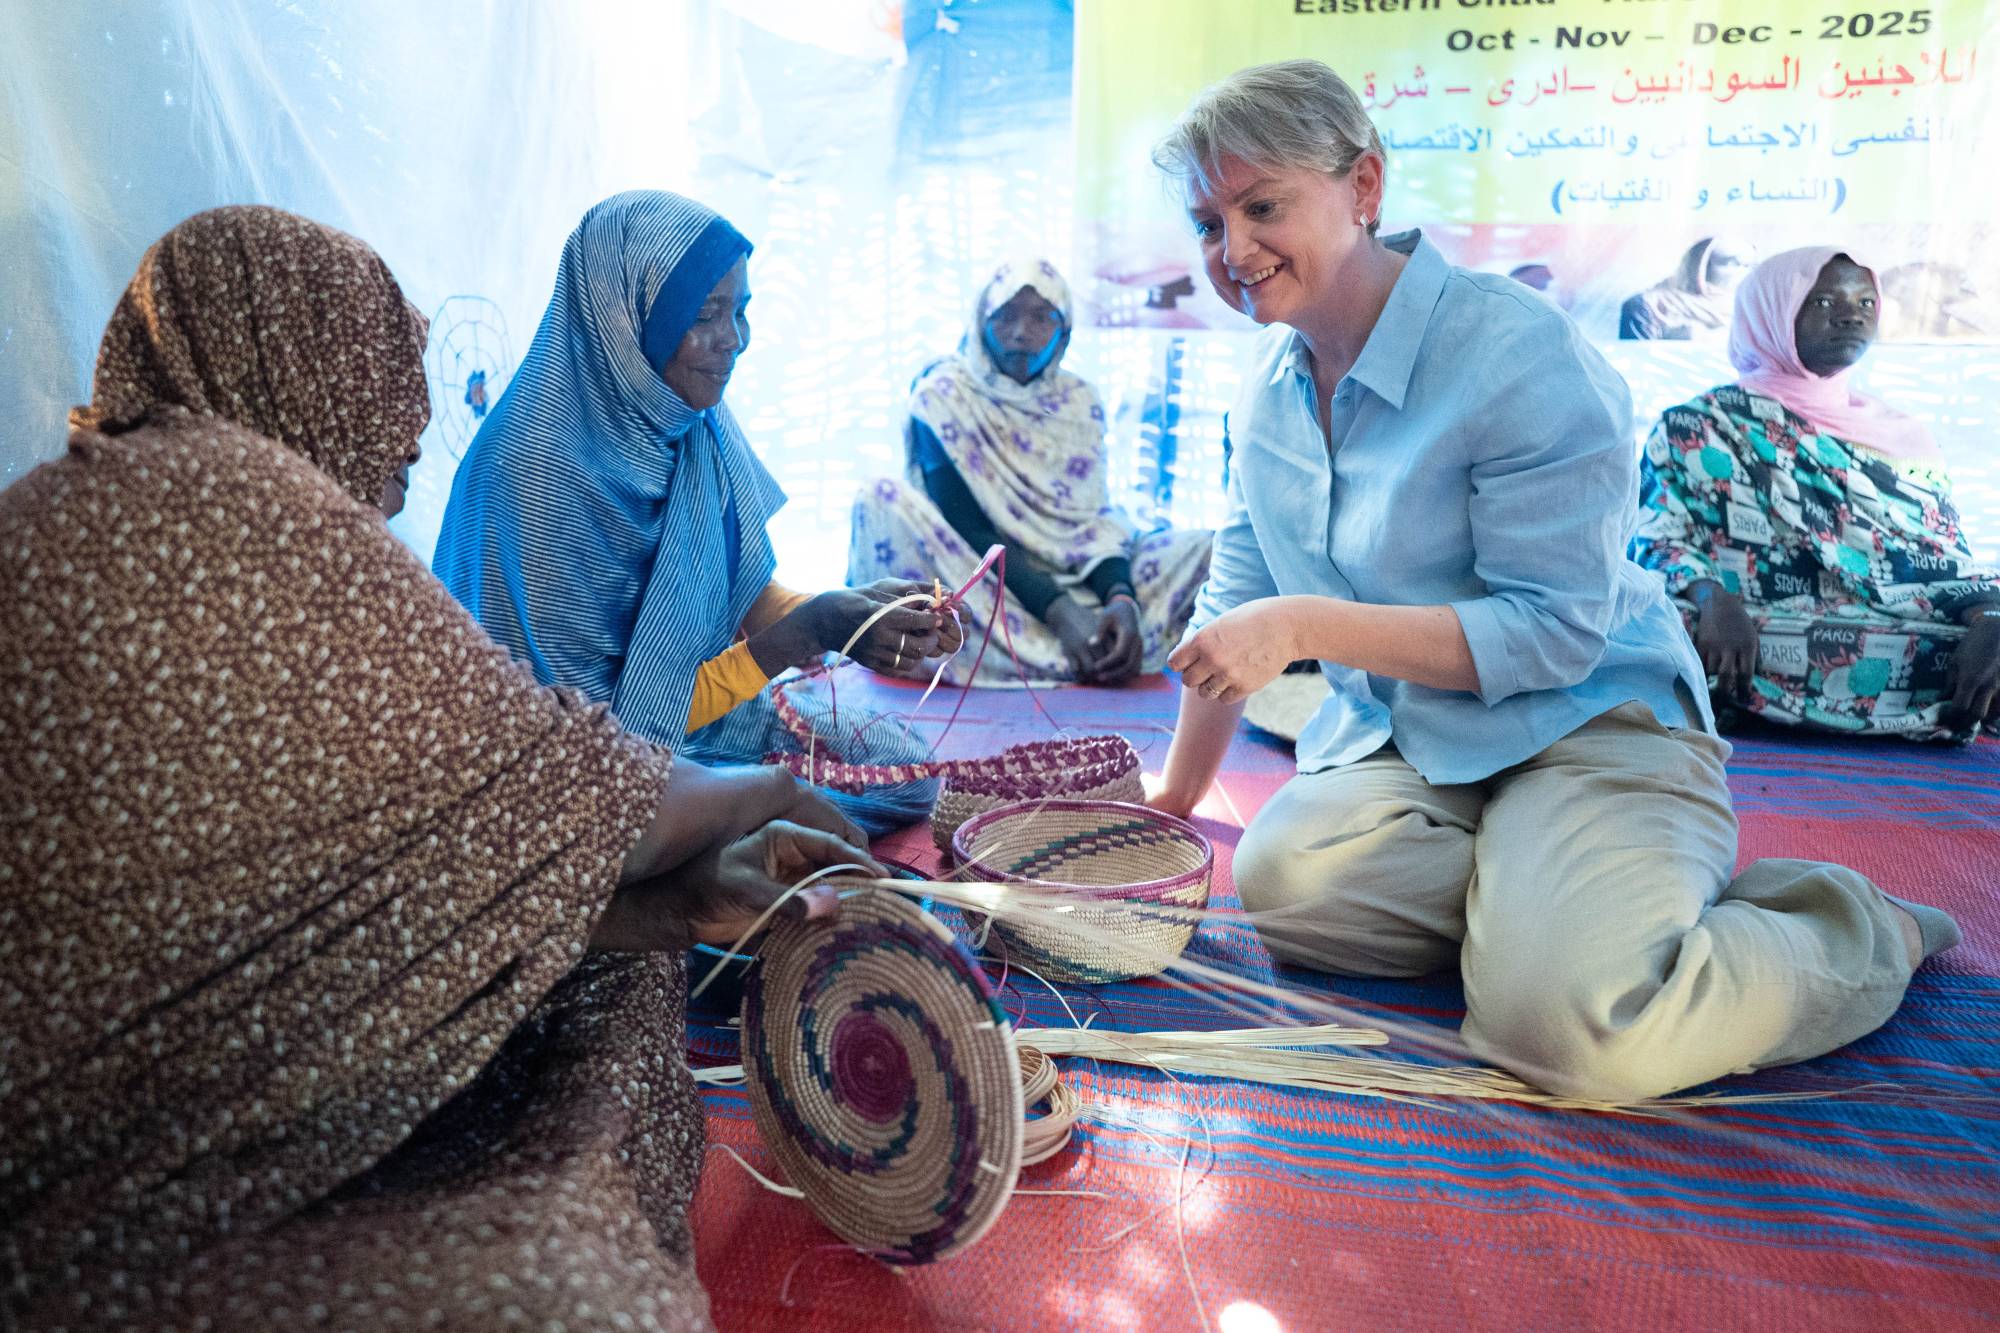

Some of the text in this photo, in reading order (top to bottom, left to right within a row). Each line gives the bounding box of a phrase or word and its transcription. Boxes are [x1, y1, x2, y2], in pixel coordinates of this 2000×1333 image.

[1446, 29, 1516, 51] Oct
[1555, 26, 1631, 49] Nov
[1692, 22, 1774, 46] Dec
[1818, 10, 1932, 40] 2025
[1732, 512, 1767, 537] PARIS
[1905, 548, 1949, 571] PARIS
[1774, 573, 1812, 594] PARIS
[1812, 628, 1857, 643] PARIS
[1760, 643, 1803, 665] PARIS
